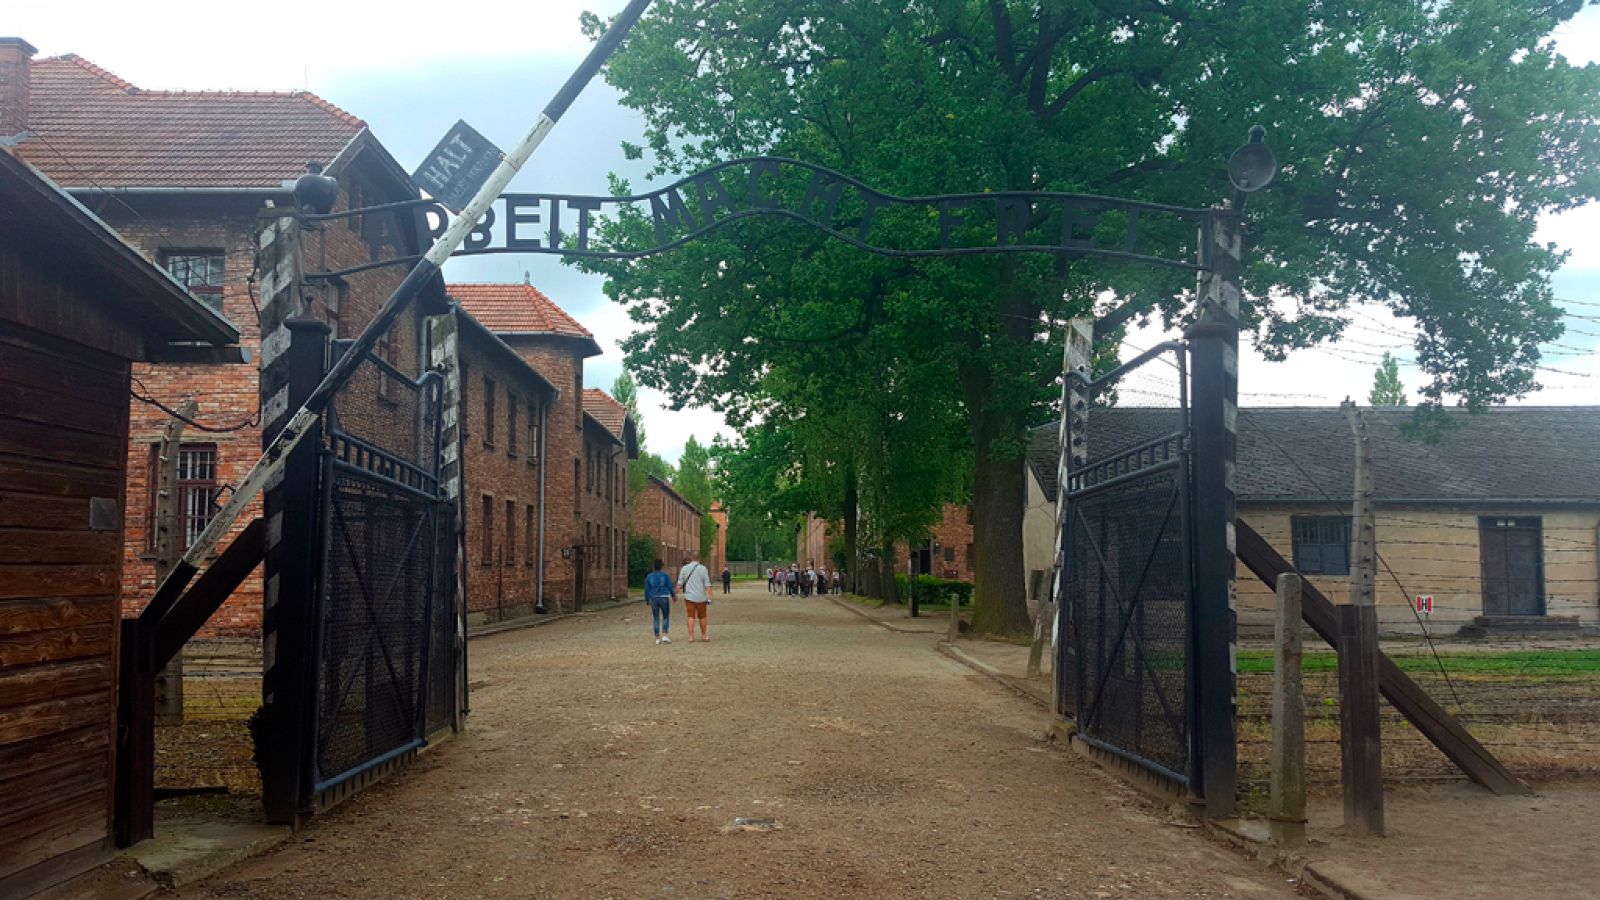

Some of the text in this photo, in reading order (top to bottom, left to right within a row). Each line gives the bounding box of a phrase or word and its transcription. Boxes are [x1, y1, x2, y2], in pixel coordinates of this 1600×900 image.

[424, 133, 473, 189] HALT
[650, 161, 886, 245] MACHT
[939, 196, 1141, 254] FREI
